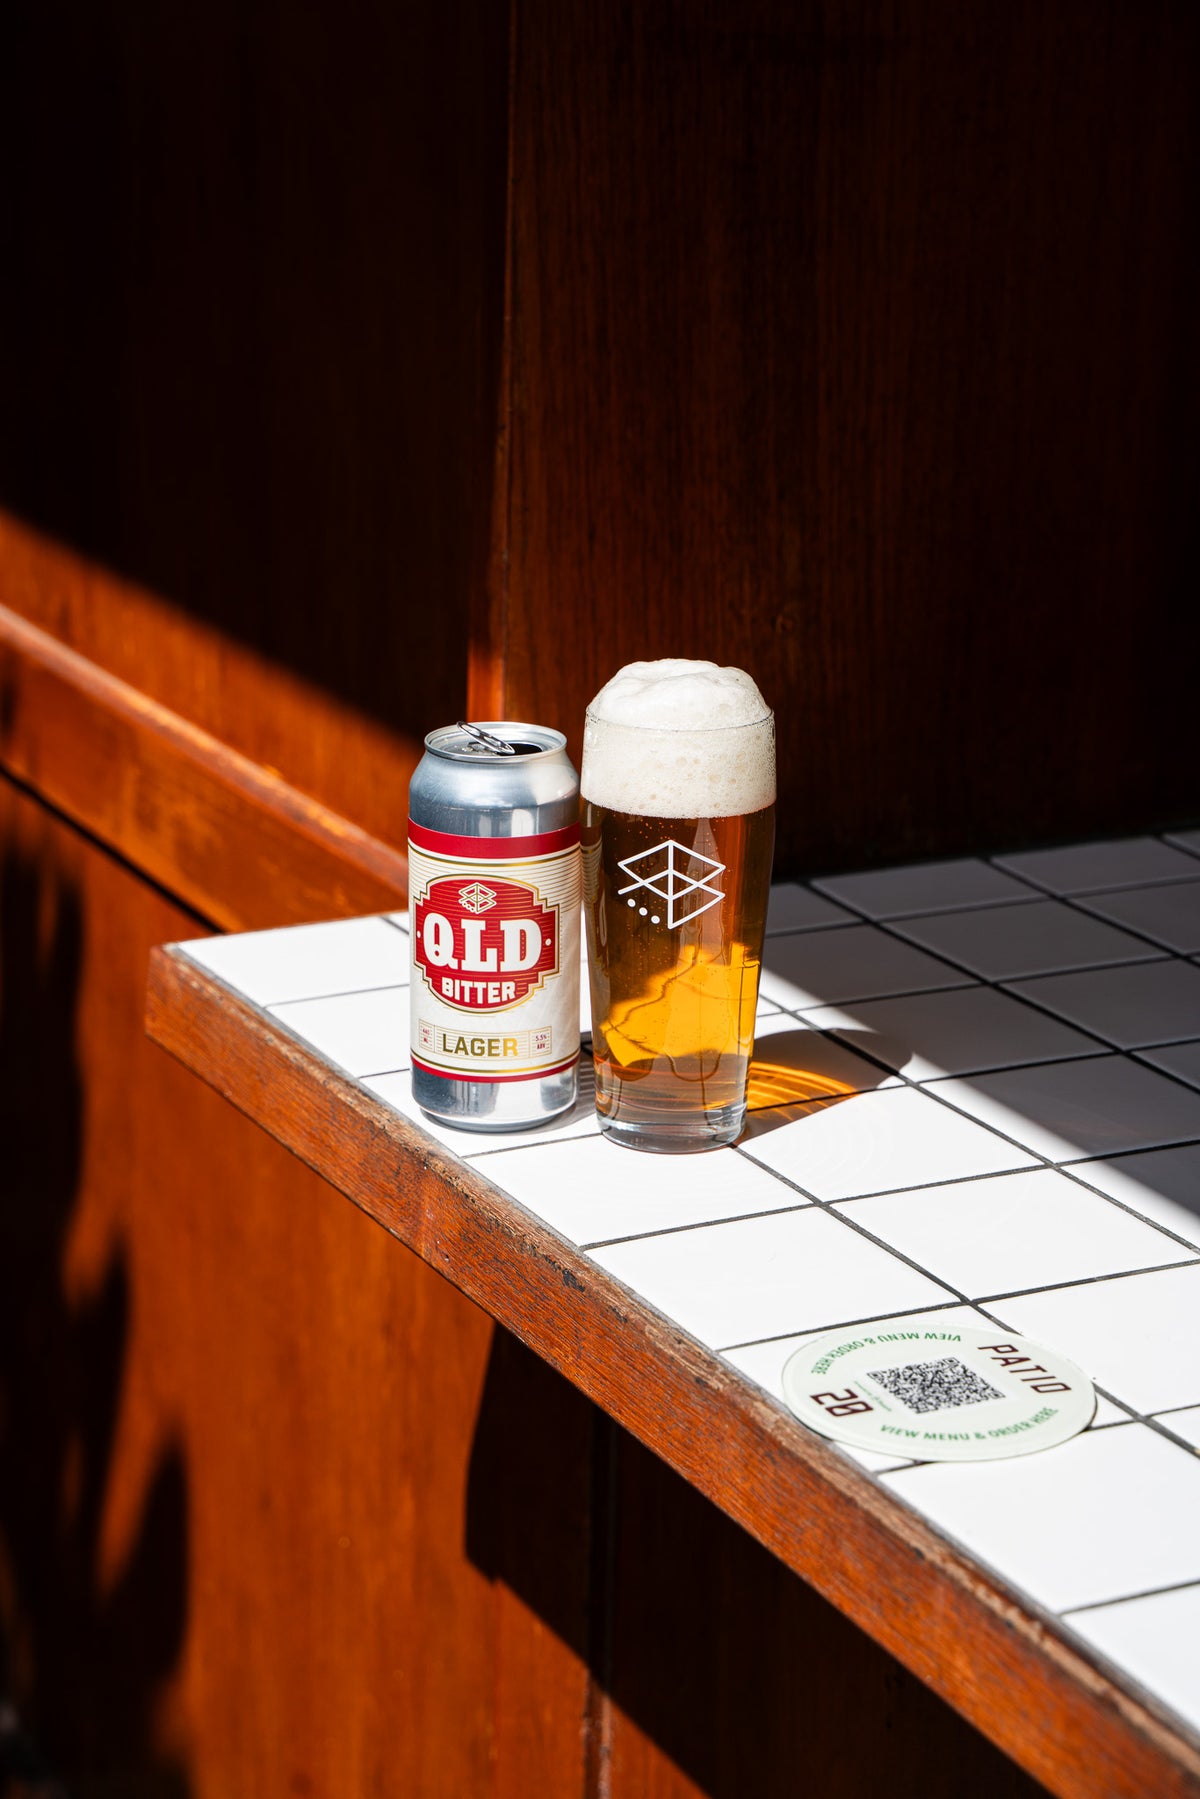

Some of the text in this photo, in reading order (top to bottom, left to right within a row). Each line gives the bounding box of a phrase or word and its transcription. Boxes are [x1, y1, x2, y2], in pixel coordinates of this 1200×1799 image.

[423, 912, 543, 973] QLD
[441, 976, 516, 1005] BITTER
[442, 1033, 519, 1057] LAGER
[863, 1337, 877, 1345] &
[877, 1332, 920, 1343] MENU
[924, 1332, 961, 1342] VIEW
[977, 1343, 1072, 1394] PATIO
[880, 1424, 920, 1438] VIEW
[923, 1432, 970, 1441] MENU
[974, 1431, 986, 1439] &
[988, 1421, 1033, 1438] ORDER
